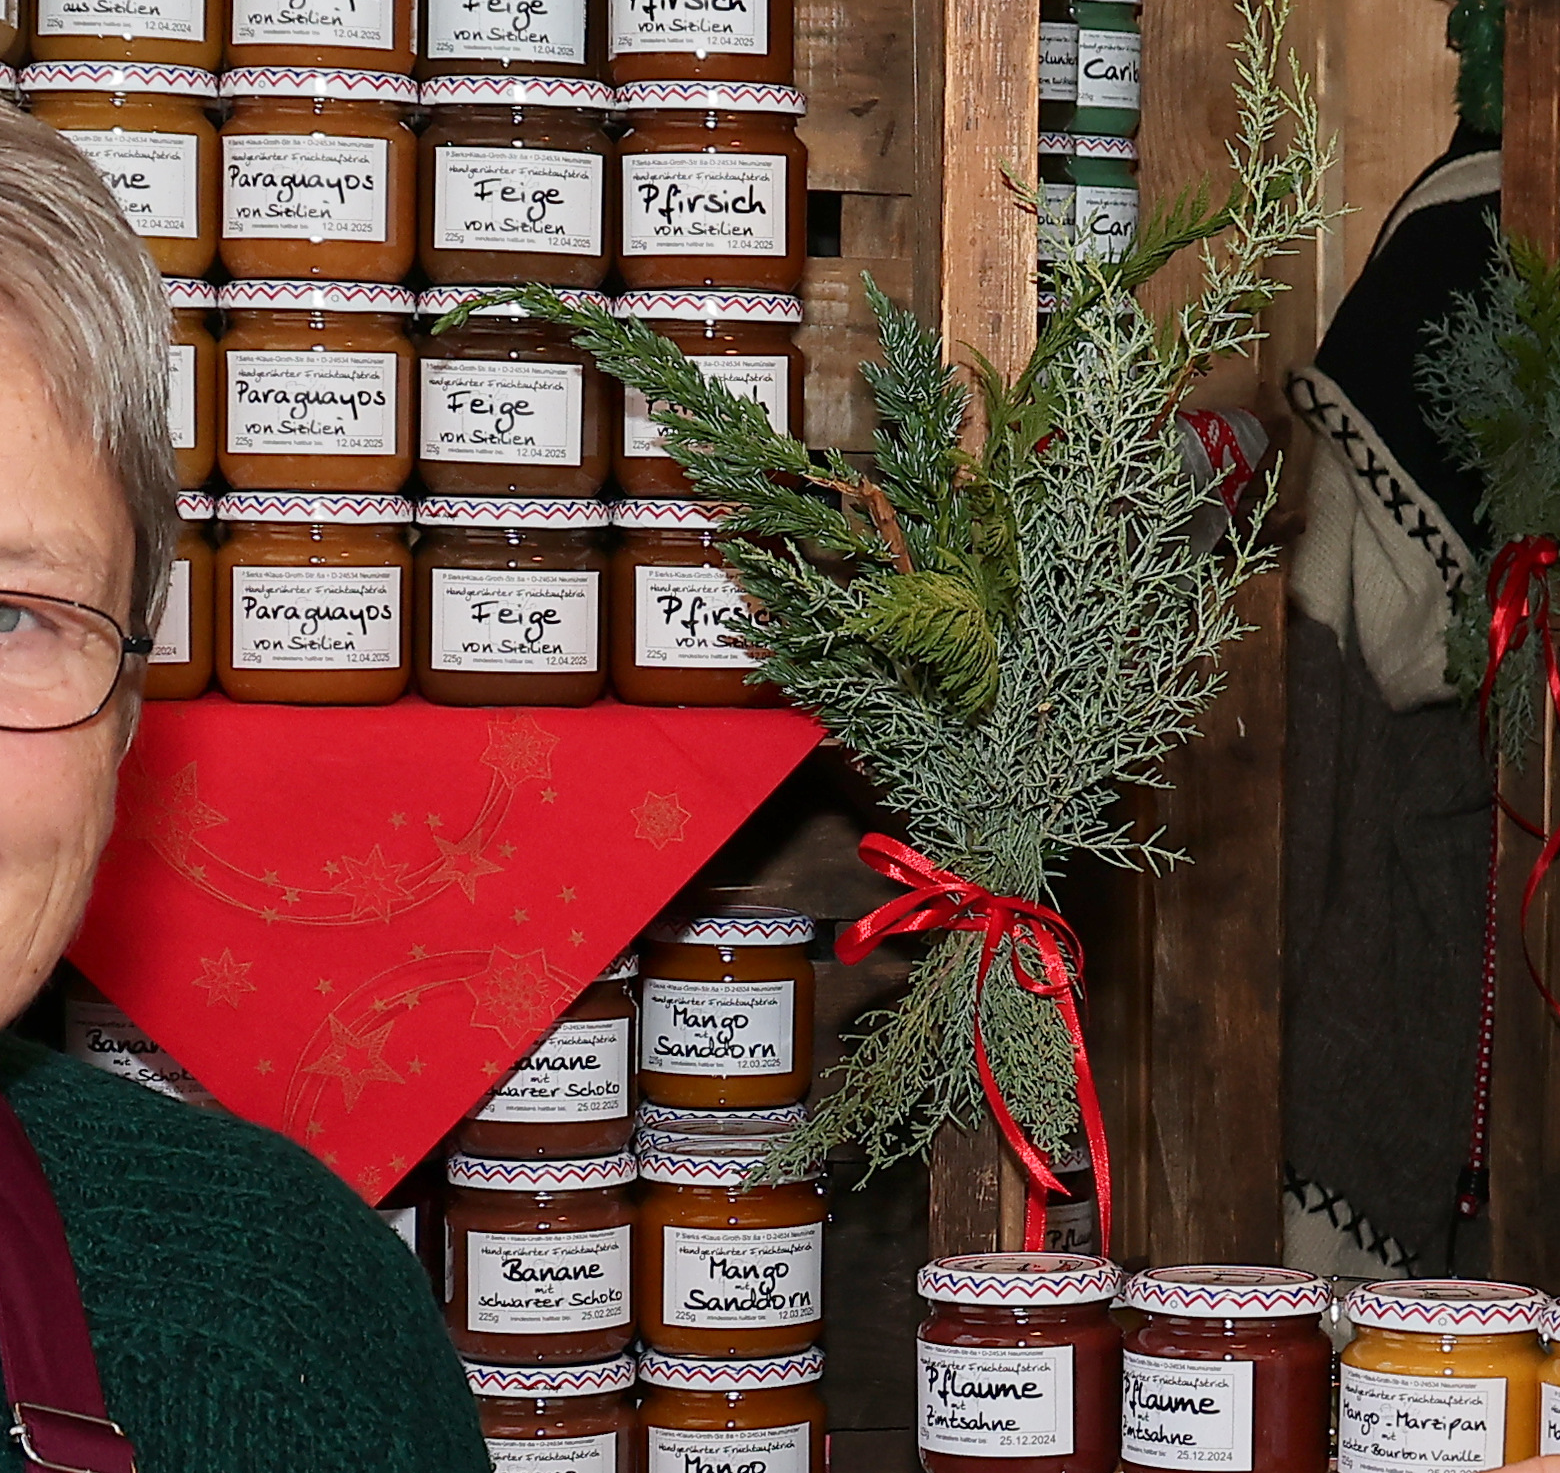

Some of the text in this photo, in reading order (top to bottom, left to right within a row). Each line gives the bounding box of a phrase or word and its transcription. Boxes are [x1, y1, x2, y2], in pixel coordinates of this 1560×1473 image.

[474, 180, 565, 223] Feige
[638, 184, 766, 224] Pfirsich
[728, 241, 773, 249] 12.04.2025
[446, 391, 535, 433] Feige
[470, 603, 562, 643] Feige
[672, 1005, 749, 1044] Mango
[653, 1036, 777, 1060] Sanddorn
[502, 1257, 605, 1282] Banane
[709, 1257, 790, 1295] Mango
[683, 1289, 812, 1311] Sanddorn
[927, 1365, 1044, 1411] Pflaume
[1000, 1434, 1057, 1446] 25.12.2024
